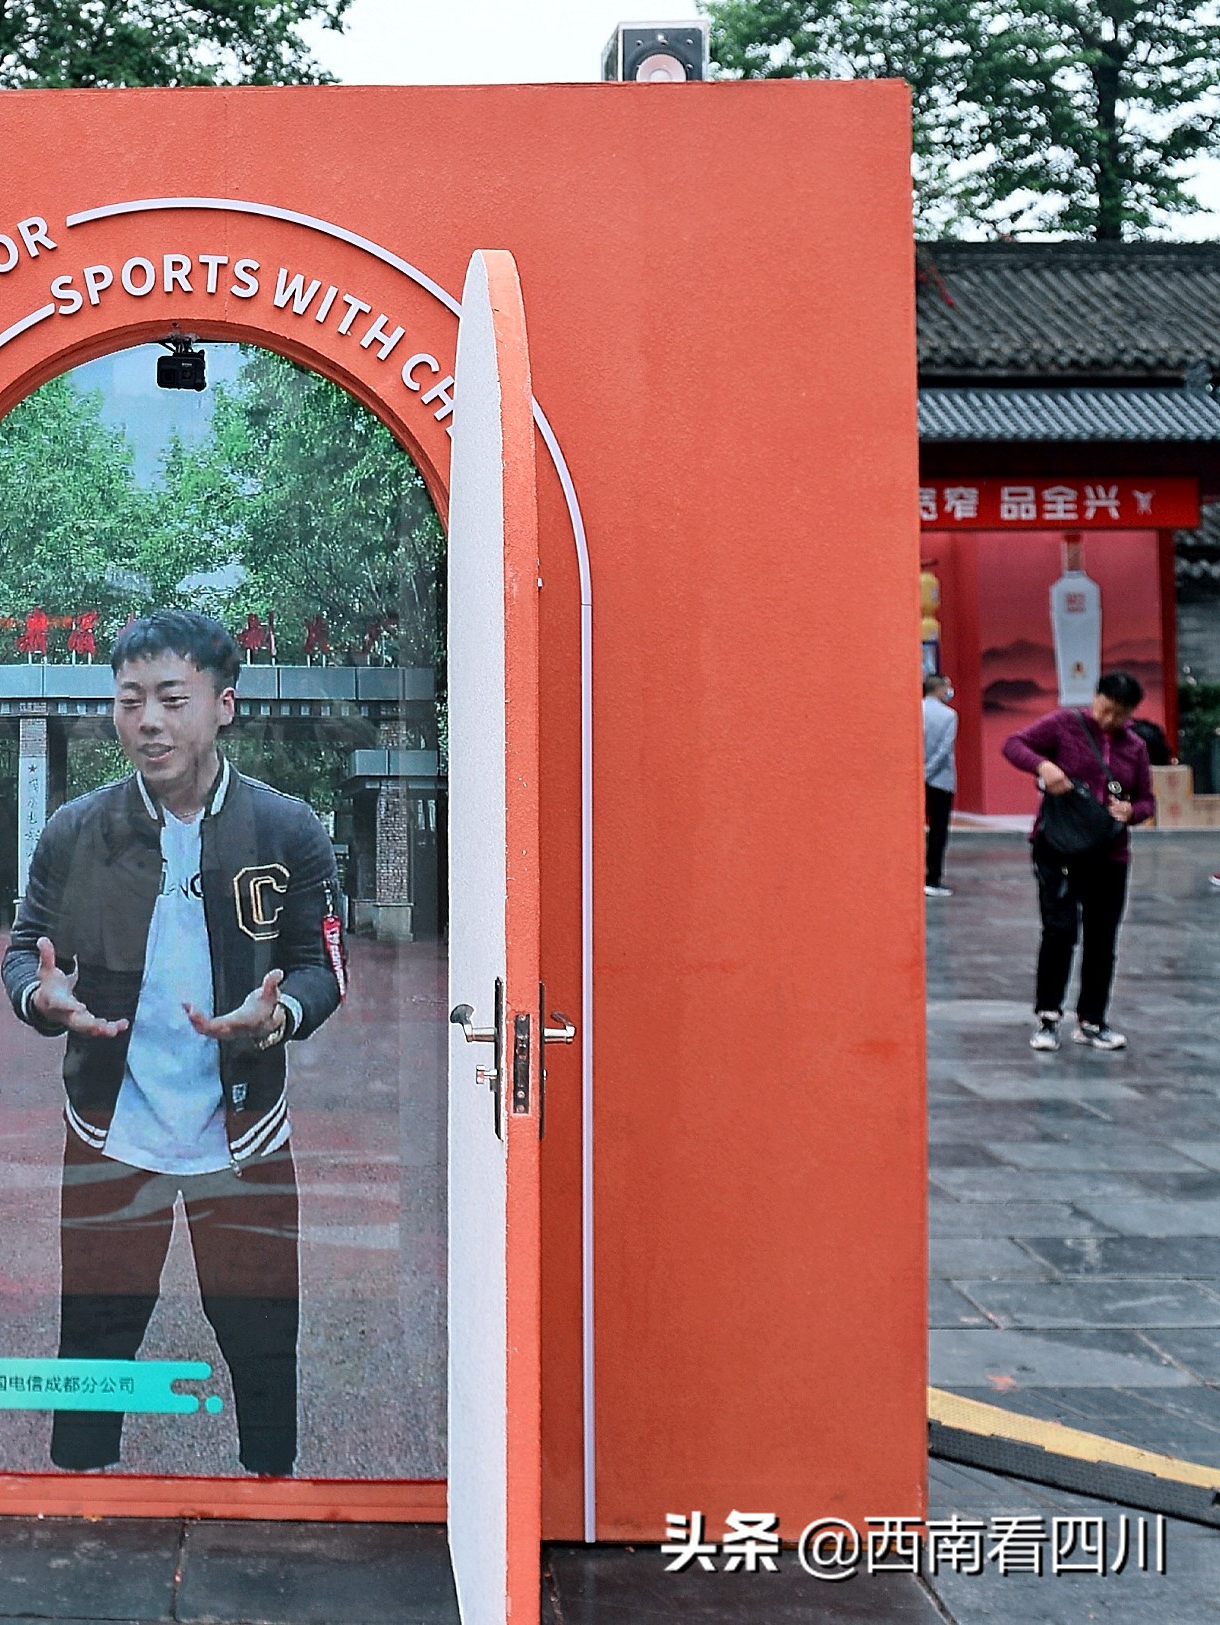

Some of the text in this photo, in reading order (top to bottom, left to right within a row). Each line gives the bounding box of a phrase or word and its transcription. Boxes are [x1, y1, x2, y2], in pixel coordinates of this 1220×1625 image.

[50, 253, 455, 442] SPORTS WITH CH
[1000, 485, 1121, 521] 品全兴
